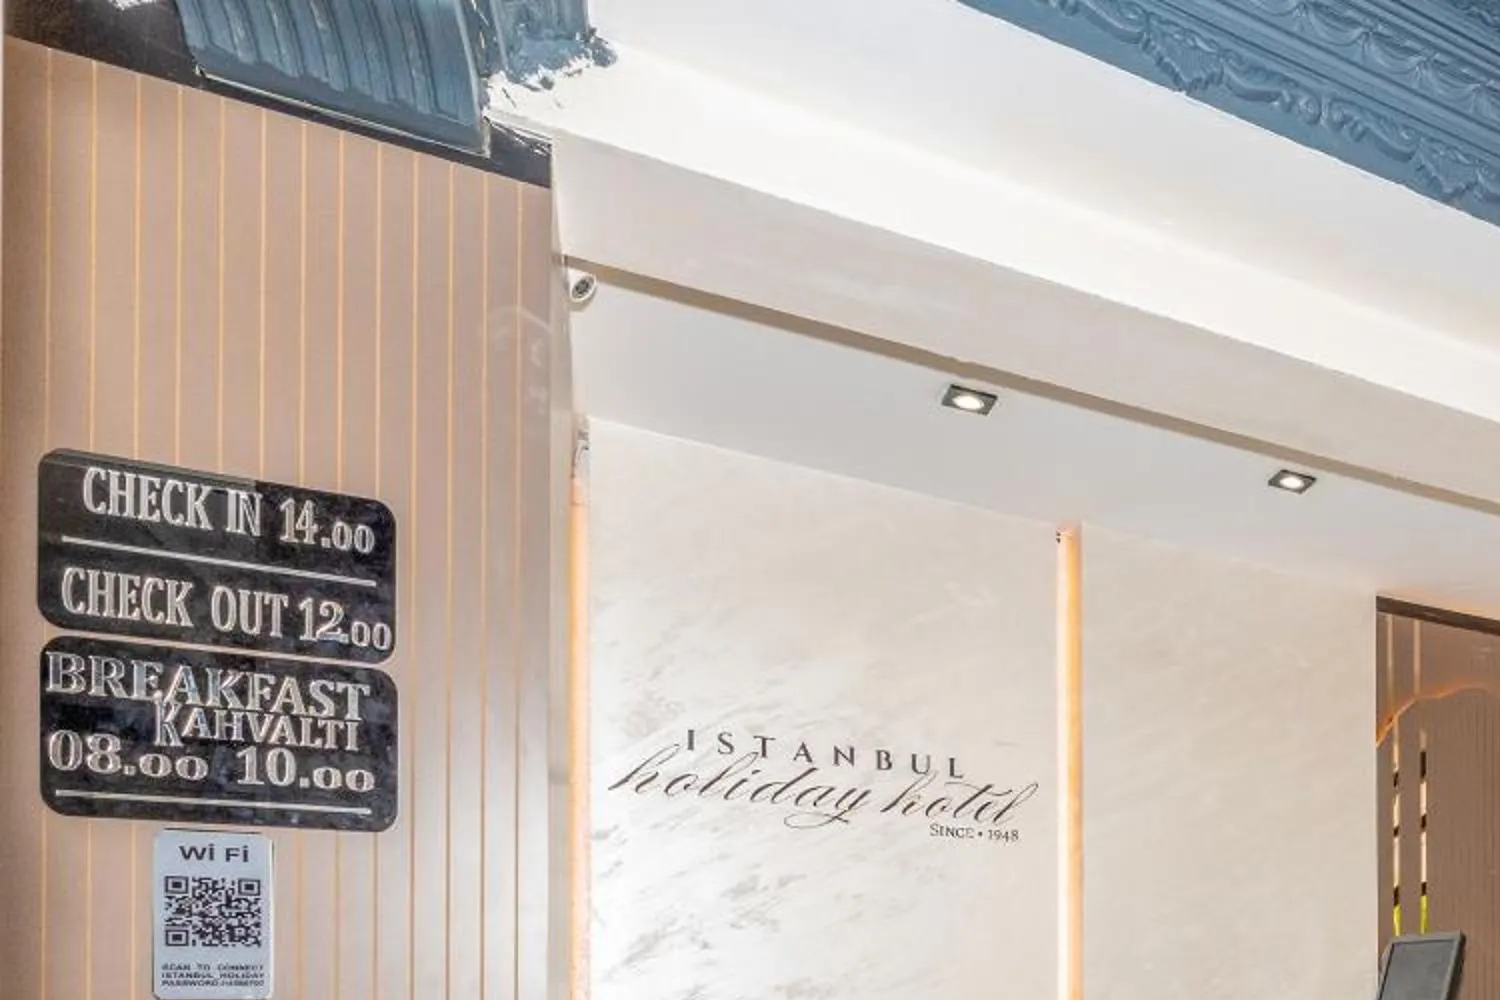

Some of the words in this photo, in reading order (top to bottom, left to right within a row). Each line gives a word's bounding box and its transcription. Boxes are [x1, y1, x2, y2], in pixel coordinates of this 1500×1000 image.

[82, 466, 213, 532] CHECK
[225, 486, 264, 537] IN
[279, 497, 376, 555] 14.00
[61, 566, 195, 629] CHECK
[210, 584, 289, 639] OUT
[298, 597, 393, 651] 12.00
[45, 650, 372, 721] BREAKFAST
[154, 699, 360, 752] KAHVALTI
[685, 728, 966, 779] ISTANBUL
[47, 728, 210, 782] 08.00
[236, 745, 376, 794] 10.00
[607, 743, 873, 830] holiday
[879, 770, 1040, 826] hotel
[929, 822, 975, 839] SINCE
[987, 829, 1020, 842] 1948
